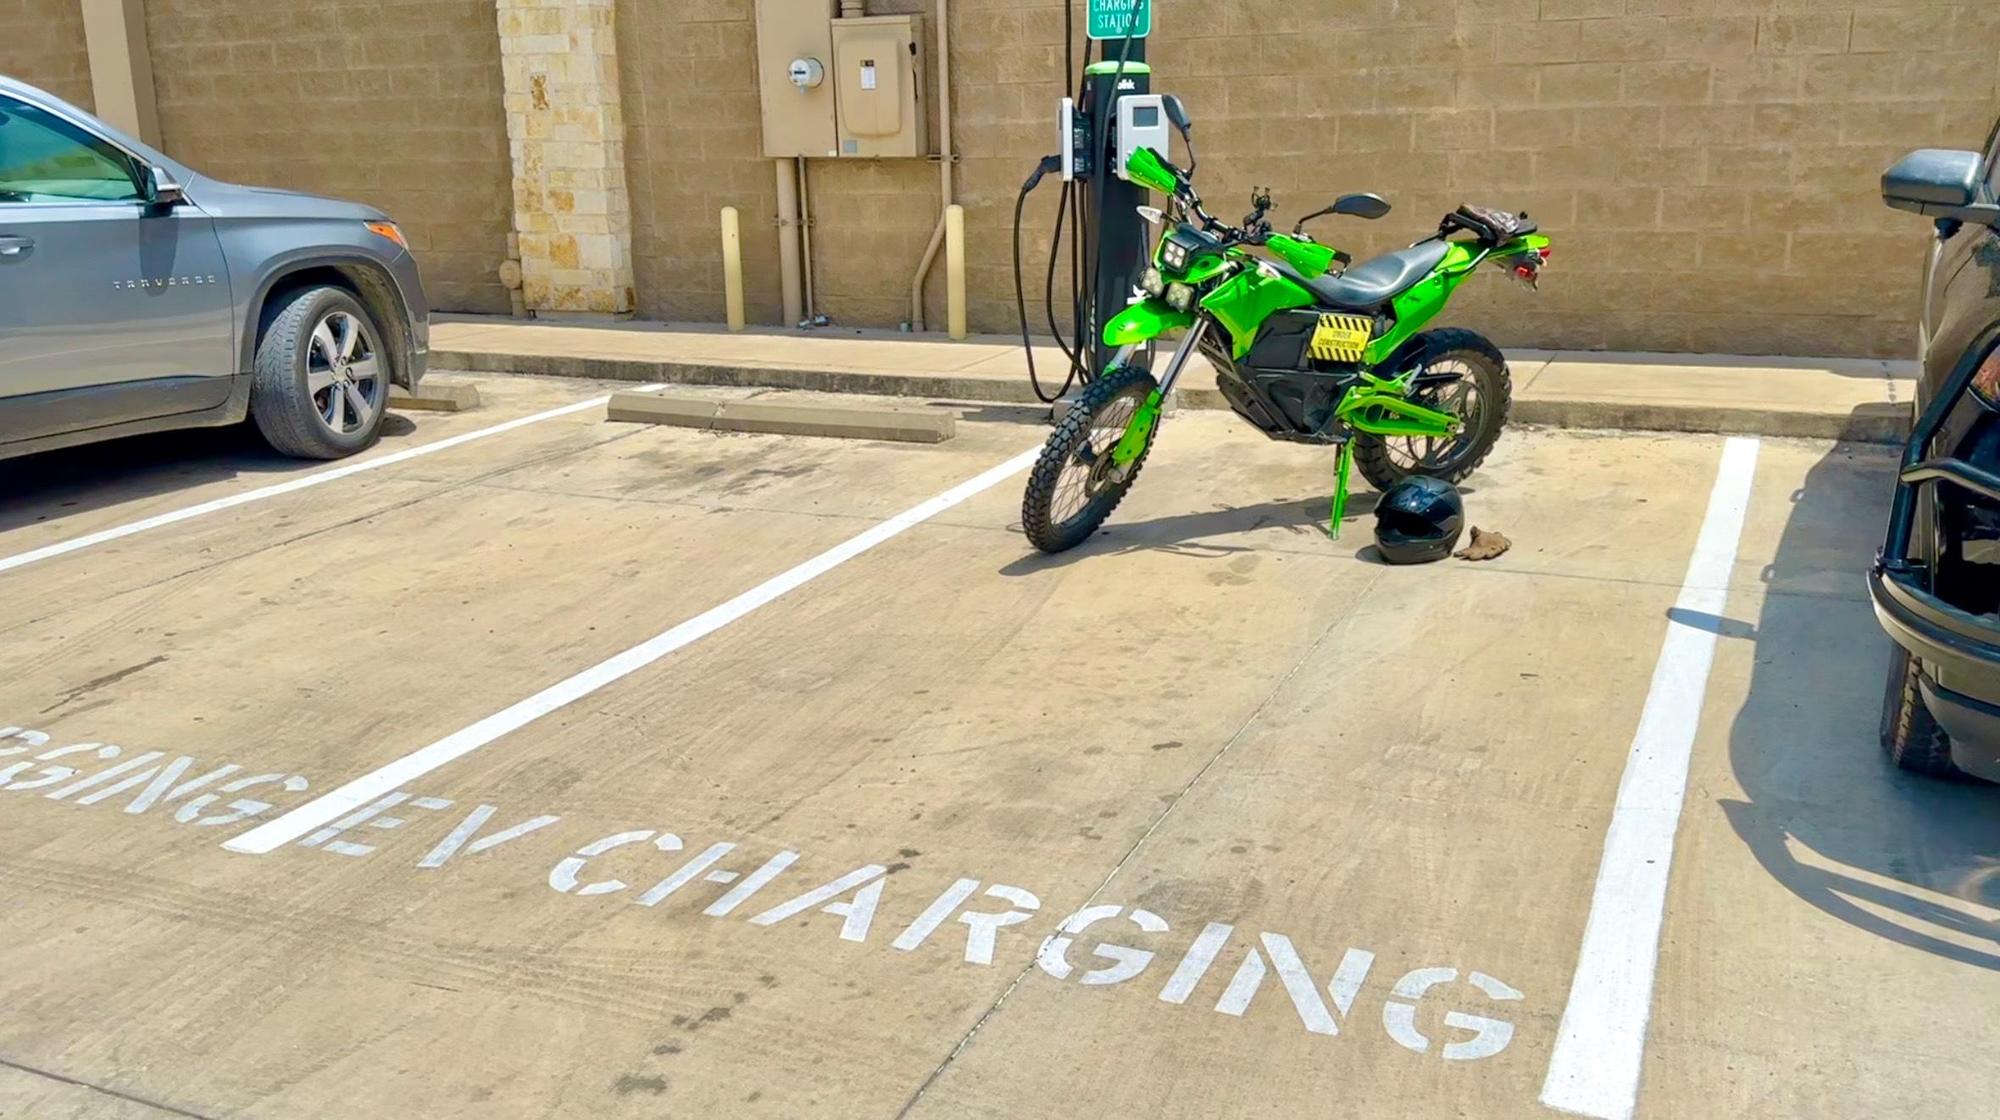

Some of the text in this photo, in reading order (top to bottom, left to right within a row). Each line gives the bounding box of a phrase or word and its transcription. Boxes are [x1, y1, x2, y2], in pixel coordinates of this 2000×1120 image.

[113, 275, 215, 289] TRAVERSE
[299, 791, 1525, 1062] EV CHARGING
